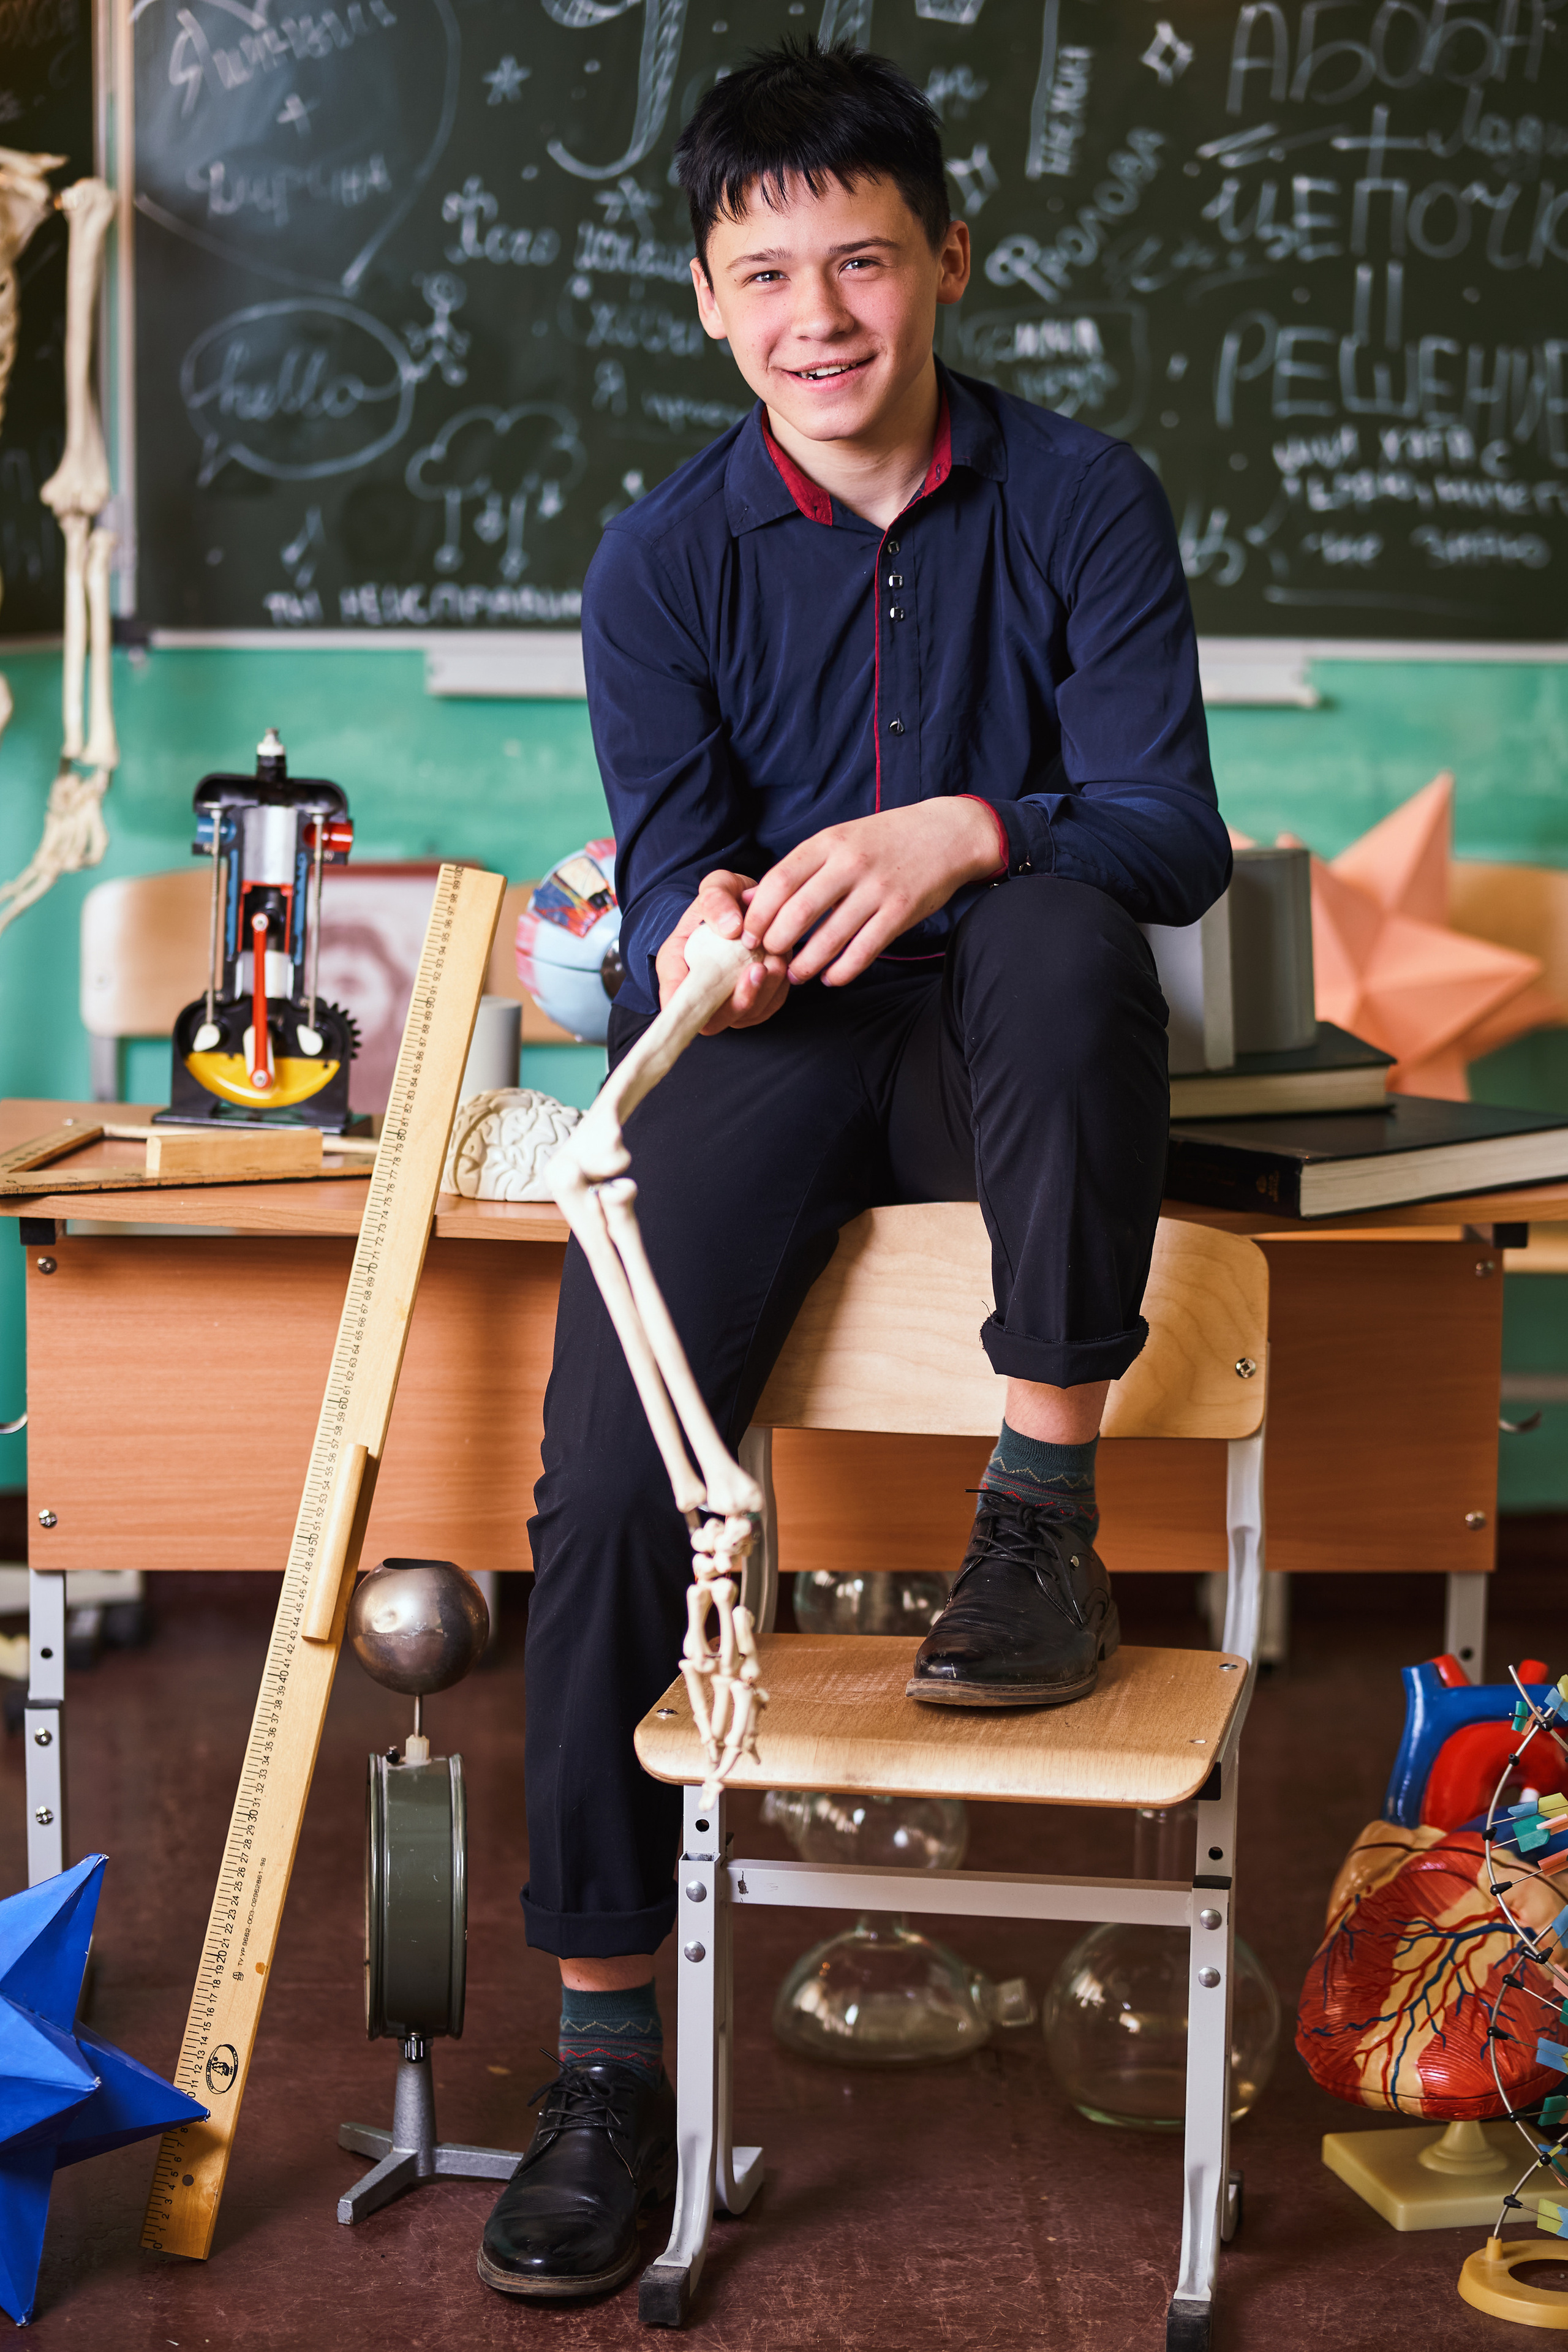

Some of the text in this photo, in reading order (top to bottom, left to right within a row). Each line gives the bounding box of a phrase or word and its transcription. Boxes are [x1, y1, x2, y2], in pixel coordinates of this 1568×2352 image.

[193, 337, 399, 423] hello
[452, 880, 461, 890] 99
[450, 893, 458, 903] 98
[446, 905, 454, 916] 97
[444, 919, 453, 929] 96
[441, 932, 450, 942] 95
[438, 946, 446, 956] 94
[434, 958, 444, 968] 93
[432, 971, 442, 981] 92
[429, 986, 437, 995] 91
[424, 997, 435, 1009] 90
[423, 1011, 433, 1021] 89
[421, 1023, 430, 1034] 88
[418, 1036, 426, 1047] 87
[415, 1050, 424, 1061] 86
[412, 1063, 421, 1074] 85
[410, 1077, 418, 1087] 84
[406, 1090, 416, 1101] 83
[403, 1103, 413, 1114] 82
[400, 1117, 409, 1127] 81
[396, 1128, 407, 1141] 80
[394, 1143, 404, 1153] 79
[391, 1156, 401, 1166] 78
[389, 1169, 398, 1180] 77
[386, 1183, 395, 1193] 76
[383, 1197, 392, 1207] 75
[380, 1210, 389, 1219] 74
[377, 1223, 386, 1233] 73
[374, 1236, 384, 1246] 72
[371, 1251, 380, 1260] 71
[367, 1262, 378, 1274] 70
[366, 1276, 375, 1287] 69
[363, 1290, 372, 1300] 68
[360, 1303, 368, 1314] 67
[357, 1317, 366, 1327] 66
[354, 1330, 364, 1341] 65
[352, 1344, 360, 1354] 64
[349, 1357, 358, 1368] 63
[345, 1370, 355, 1381] 62
[342, 1385, 351, 1395] 61
[337, 1396, 349, 1409] 60
[337, 1411, 345, 1422] 59
[334, 1425, 343, 1436] 58
[330, 1438, 339, 1449] 57
[328, 1452, 337, 1463] 56
[325, 1466, 334, 1477] 55
[322, 1480, 330, 1490] 54
[318, 1493, 328, 1504] 53
[315, 1507, 325, 1518] 52
[312, 1521, 321, 1531] 51
[307, 1533, 319, 1546] 50
[307, 1547, 316, 1558] 49
[304, 1561, 313, 1572] 48
[301, 1575, 309, 1586] 47
[298, 1589, 307, 1600] 46
[295, 1602, 304, 1613] 45
[292, 1617, 300, 1627] 44
[289, 1630, 298, 1641] 43
[285, 1643, 295, 1655] 42
[283, 1658, 292, 1668] 41
[279, 1670, 289, 1683] 40
[276, 1685, 286, 1696] 39
[273, 1699, 283, 1710] 38
[270, 1713, 279, 1724] 37
[267, 1727, 277, 1738] 36
[264, 1741, 274, 1752] 35
[262, 1755, 270, 1766] 34
[258, 1769, 268, 1780] 33
[255, 1782, 265, 1794] 32
[252, 1797, 261, 1807] 31
[247, 1809, 258, 1822] 30
[246, 1825, 255, 1836] 29
[243, 1839, 252, 1850] 28
[239, 1852, 249, 1864] 27
[236, 1866, 246, 1878] 26
[233, 1881, 243, 1892] 25
[230, 1895, 239, 1906] 24
[227, 1909, 236, 1920] 23
[224, 1923, 234, 1934] 22
[221, 1938, 230, 1948] 21
[216, 1950, 227, 1964] 20
[216, 1964, 224, 1975] 19
[212, 1979, 221, 1989] 18
[209, 1992, 217, 2003] 17
[206, 2007, 215, 2017] 16
[202, 2021, 211, 2032] 15
[200, 2036, 209, 2046] 14
[196, 2050, 205, 2060] 13
[193, 2064, 203, 2074] 12
[190, 2079, 199, 2089] 11
